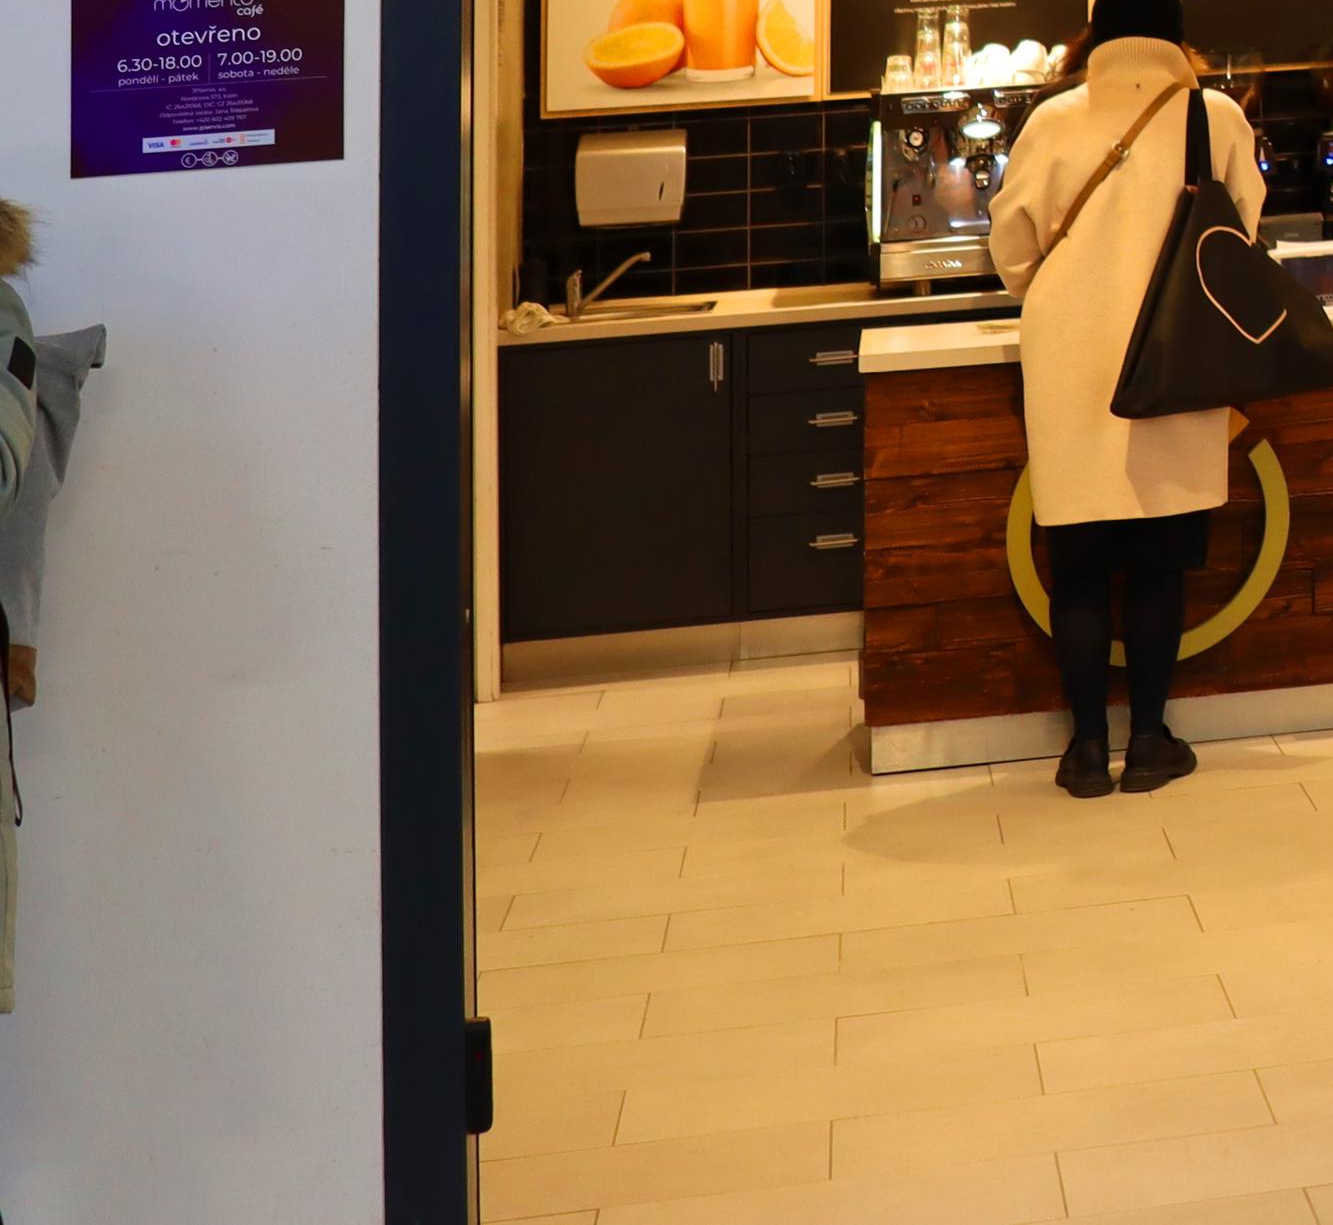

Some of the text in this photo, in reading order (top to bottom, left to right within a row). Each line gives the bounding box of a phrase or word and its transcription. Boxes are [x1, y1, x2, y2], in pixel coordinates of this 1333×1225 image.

[236, 3, 264, 17] café
[156, 25, 262, 46] otevřeno
[117, 54, 203, 73] 6.30-18.00
[217, 47, 303, 66] 7.00-19.00
[117, 72, 199, 88] pondělí pátek
[217, 64, 300, 80] sobota neděle
